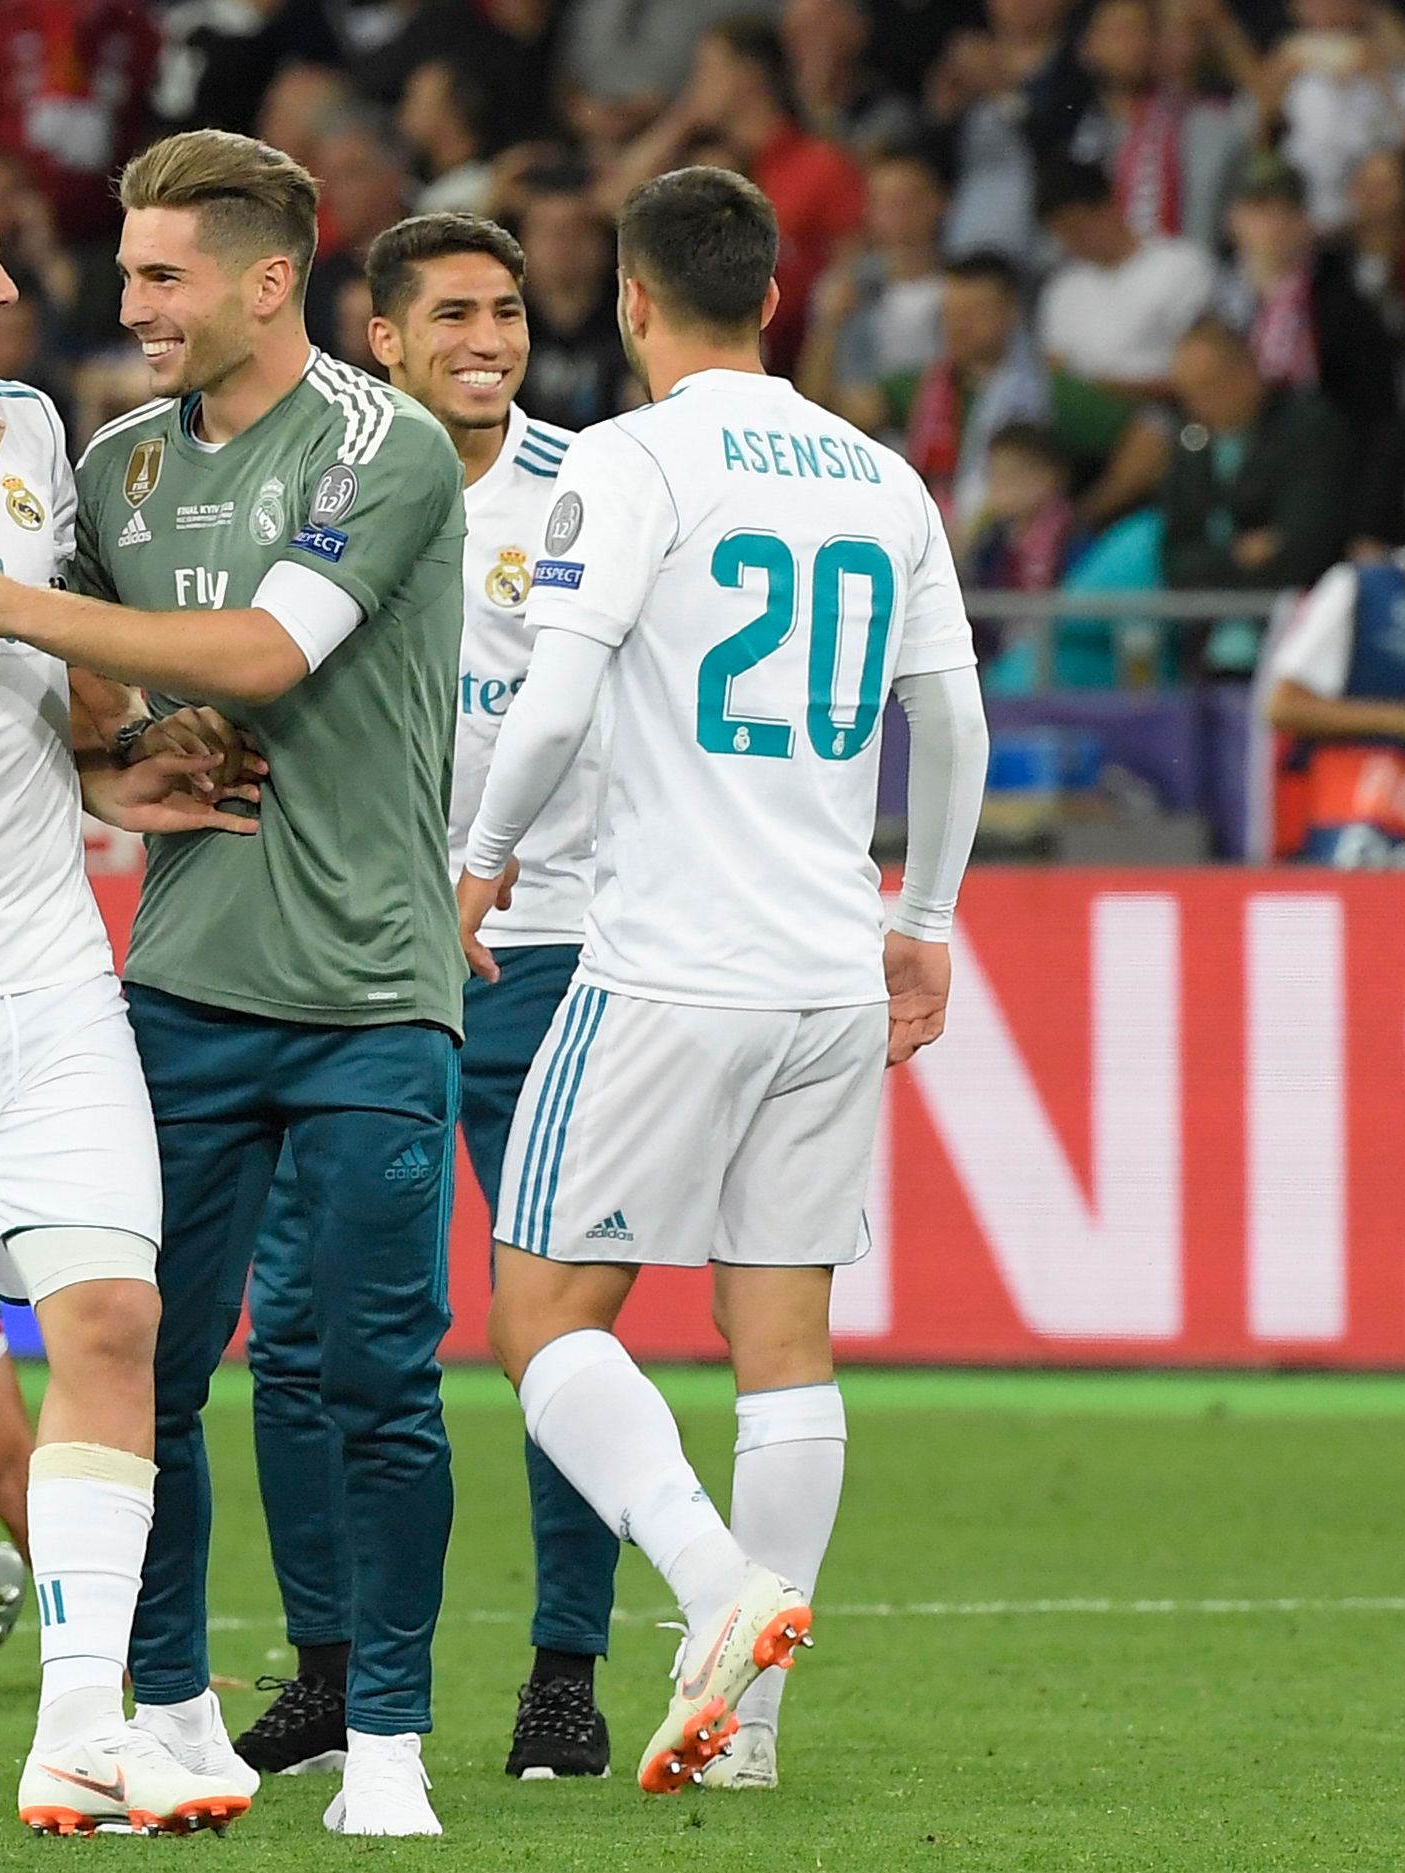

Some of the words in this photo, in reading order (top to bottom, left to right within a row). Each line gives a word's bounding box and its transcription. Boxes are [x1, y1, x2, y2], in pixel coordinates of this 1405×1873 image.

[722, 427, 881, 484] ASENSIO
[317, 496, 339, 513] 12
[552, 521, 569, 538] 12
[117, 530, 153, 548] adidas
[174, 566, 229, 610] Fly
[696, 526, 894, 761] 20
[585, 1228, 635, 1242] adidas
